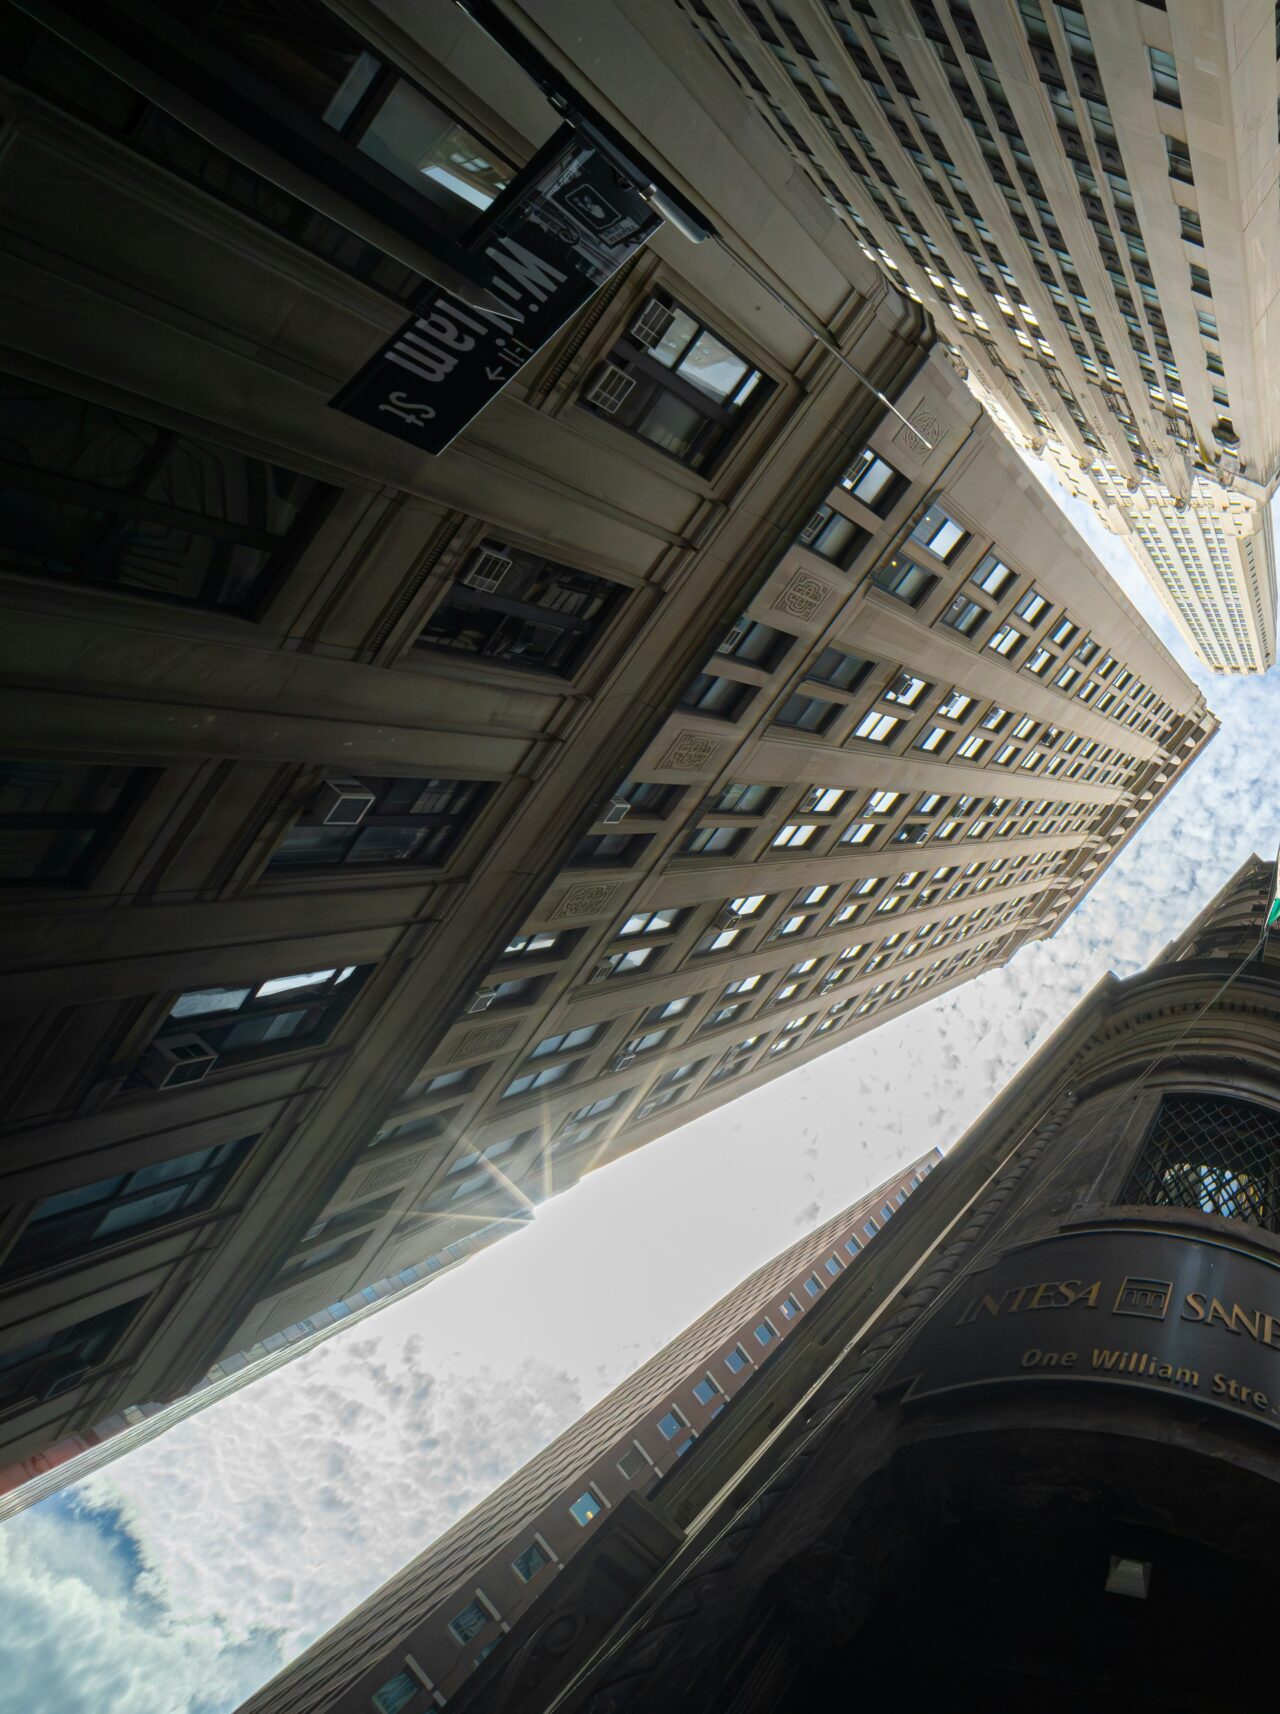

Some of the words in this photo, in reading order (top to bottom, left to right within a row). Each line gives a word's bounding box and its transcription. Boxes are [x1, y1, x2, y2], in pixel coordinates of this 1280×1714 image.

[379, 391, 436, 427] St
[955, 1278, 1100, 1327] INTESA
[1020, 1348, 1077, 1369] One
[1091, 1348, 1199, 1388] William
